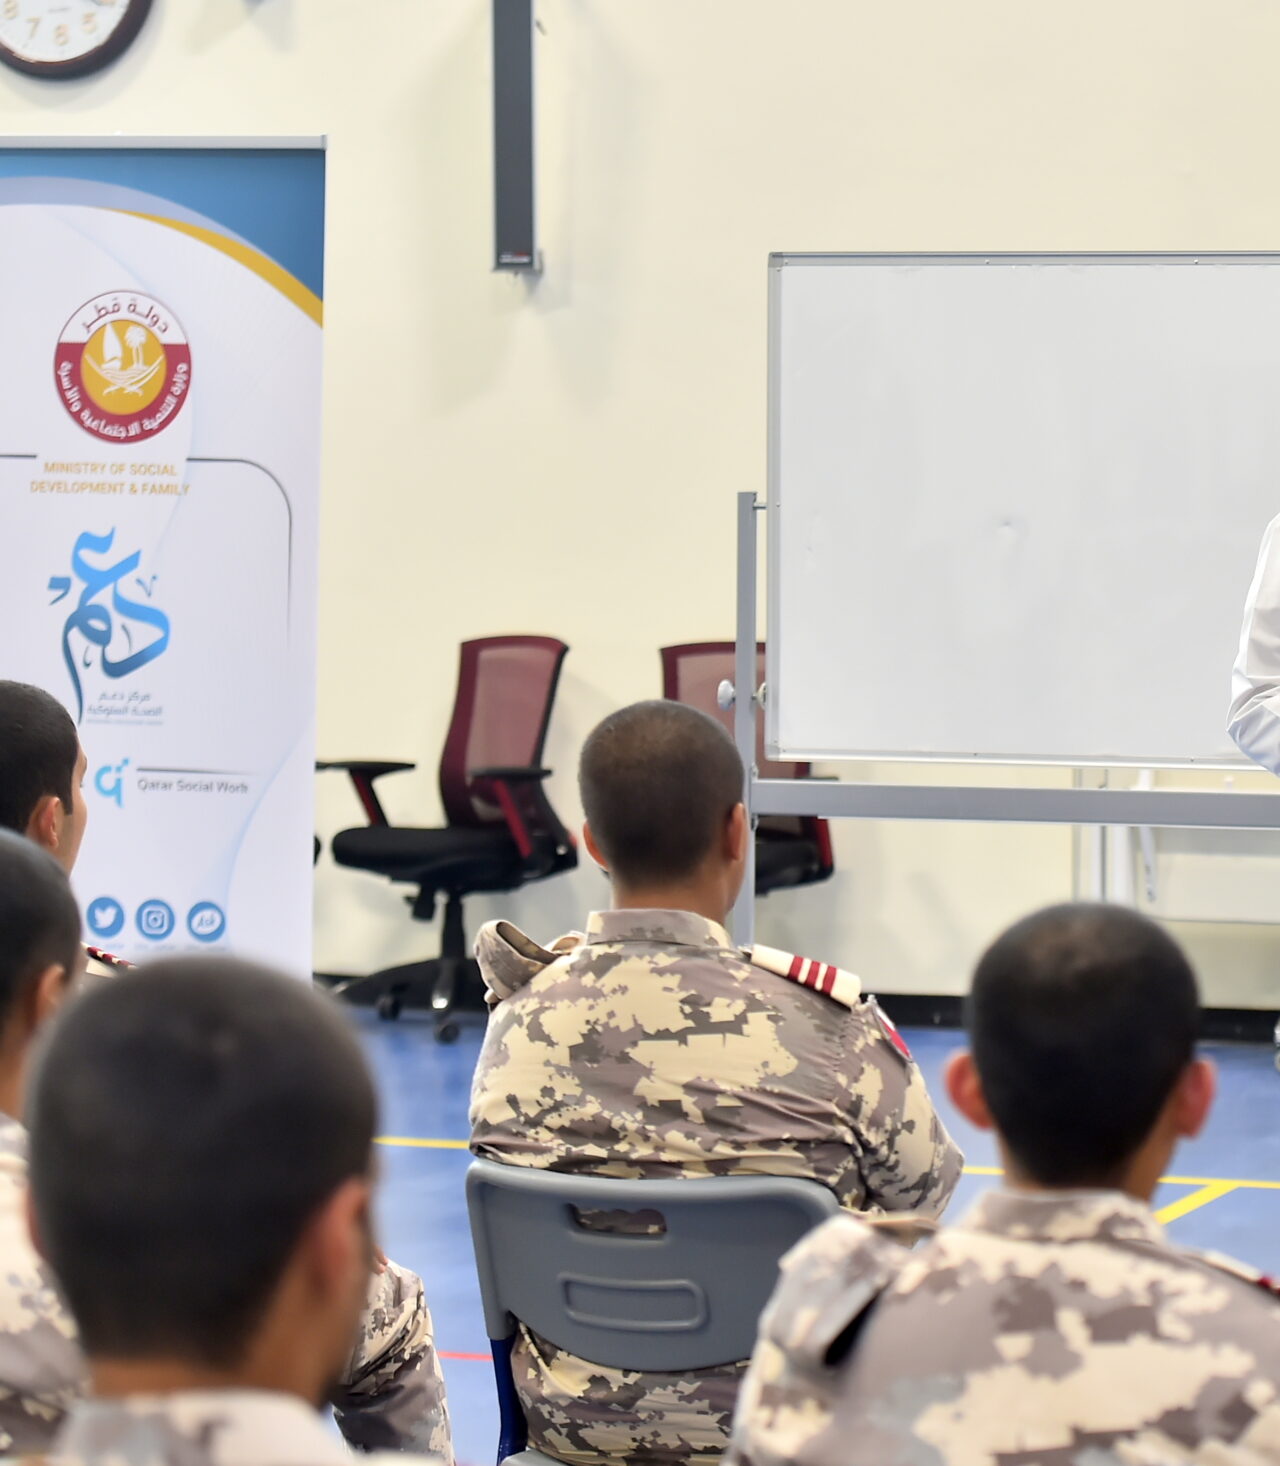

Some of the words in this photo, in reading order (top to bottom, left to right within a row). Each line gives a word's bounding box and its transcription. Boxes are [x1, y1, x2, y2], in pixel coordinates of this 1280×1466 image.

[82, 297, 121, 334] قطر
[127, 298, 169, 333] دولة
[43, 462, 107, 475] MINISTRY
[109, 463, 126, 476] OF
[129, 464, 178, 477] SOCIAL
[30, 480, 126, 495] DEVELOPMENT
[128, 482, 139, 496] &
[141, 483, 192, 497] FAMILY
[137, 777, 175, 793] Qatar
[178, 778, 213, 793] Social
[216, 780, 249, 795] Work
